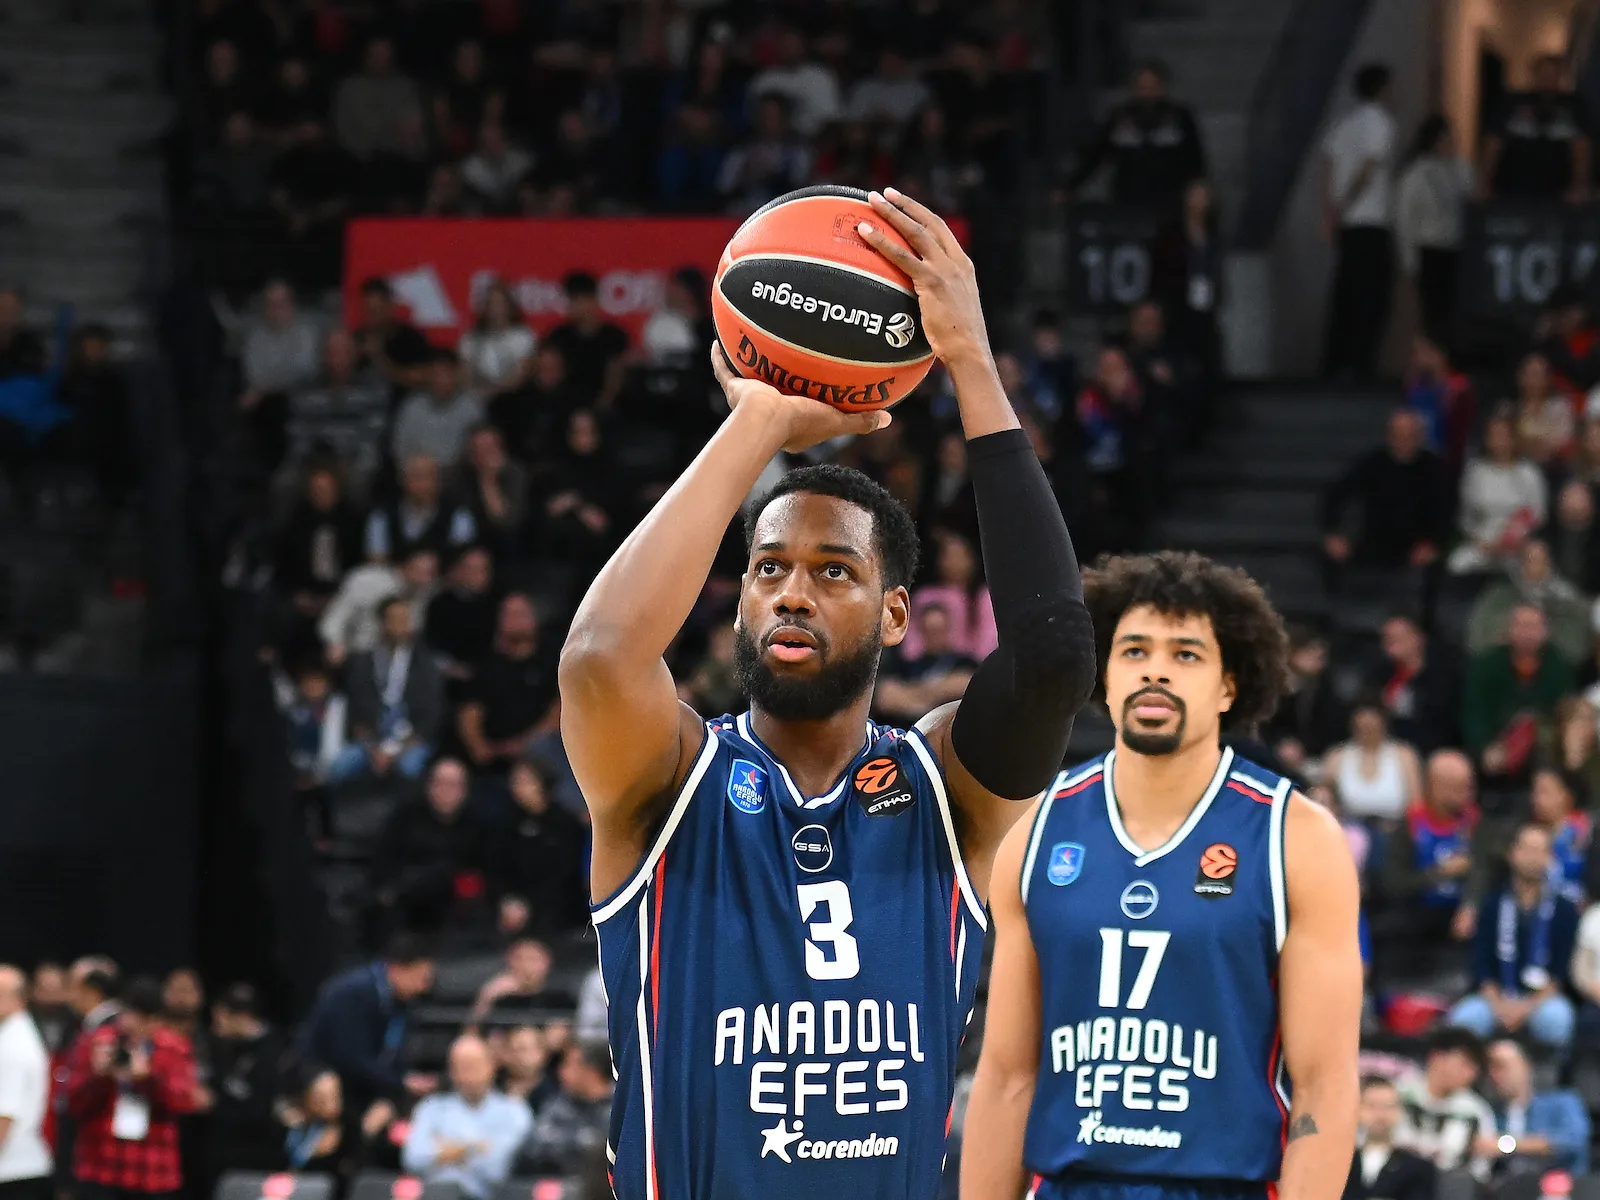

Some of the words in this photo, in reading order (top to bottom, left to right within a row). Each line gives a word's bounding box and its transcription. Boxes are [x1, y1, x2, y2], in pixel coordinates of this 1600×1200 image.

[751, 280, 884, 336] EuroLeague
[736, 332, 896, 405] SPALDING
[736, 791, 758, 806] EFES
[867, 793, 912, 814] ETIHAD
[794, 842, 830, 853] GSA
[796, 880, 861, 981] 3
[1098, 928, 1172, 1010] 17
[1051, 1016, 1218, 1080] ANADOLU
[750, 1059, 909, 1117] EFES
[1075, 1064, 1190, 1112] EFES
[796, 1132, 899, 1160] corendon
[1093, 1124, 1182, 1149] corendon
